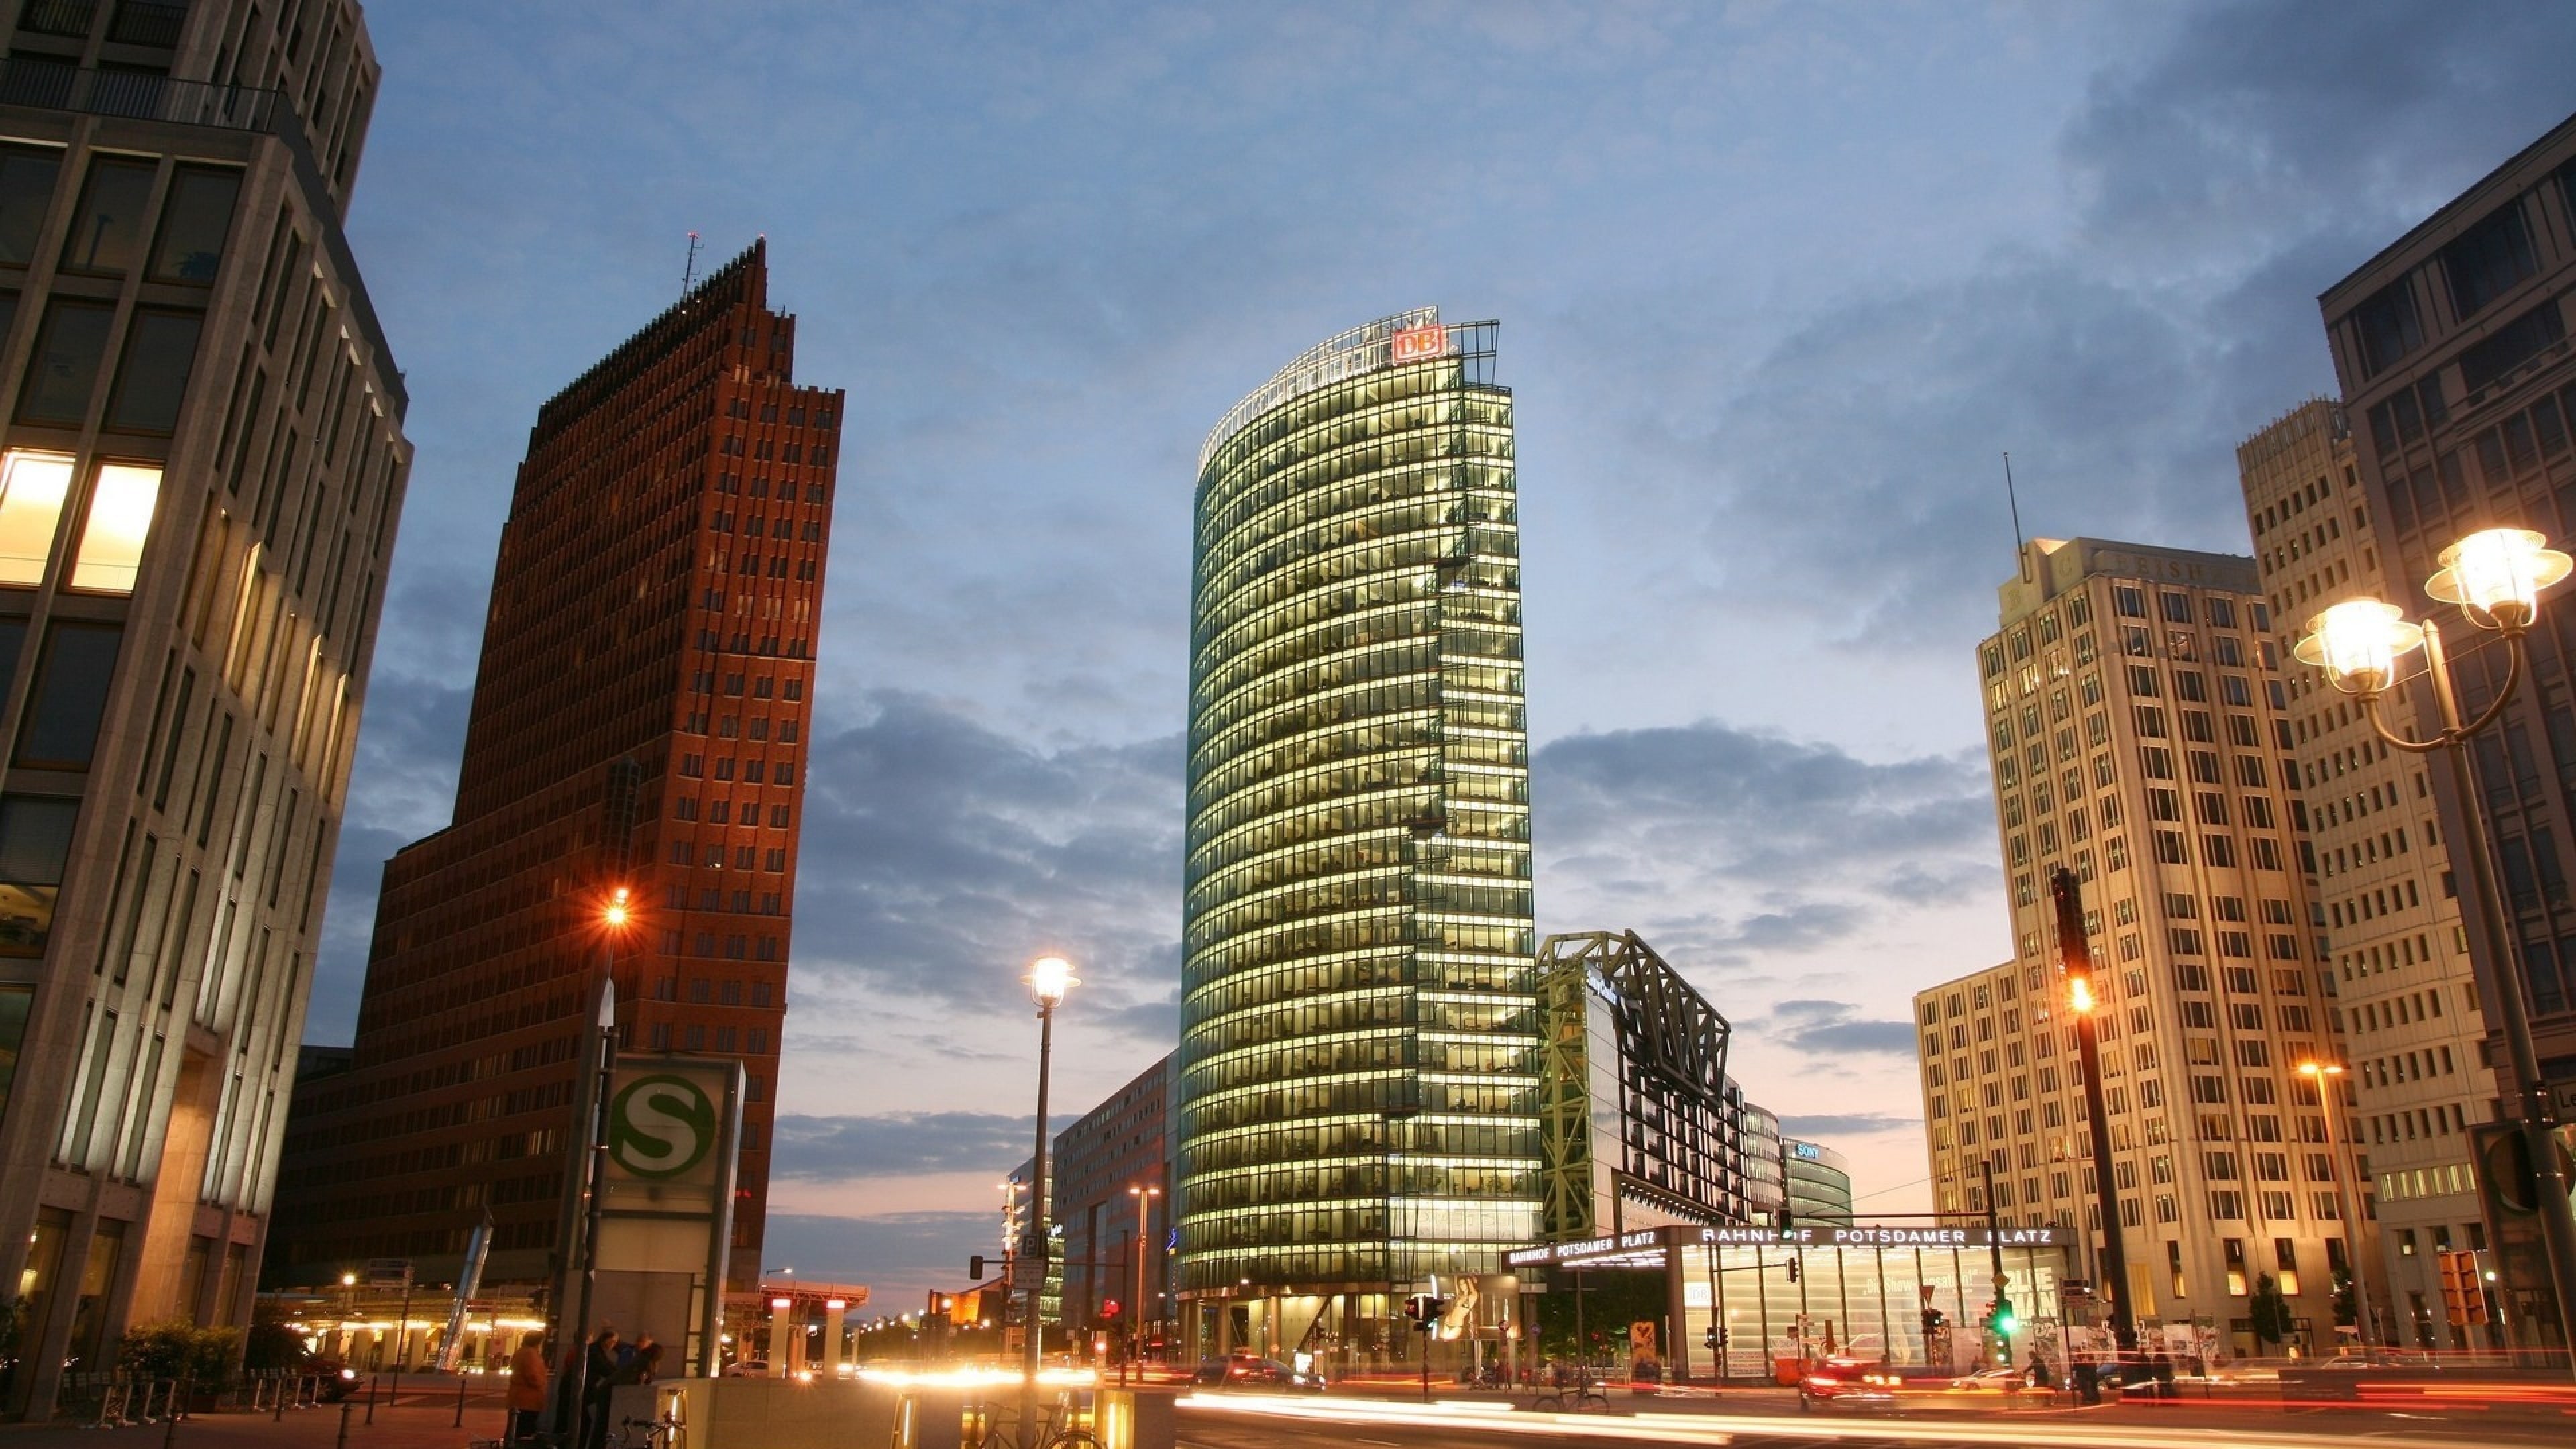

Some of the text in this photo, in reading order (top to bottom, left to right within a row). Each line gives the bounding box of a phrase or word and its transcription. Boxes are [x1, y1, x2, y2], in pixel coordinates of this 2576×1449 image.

[1399, 331, 1436, 356] DB
[621, 1082, 697, 1171] S
[1797, 1143, 1819, 1159] SONY
[1509, 1230, 1656, 1264] BAHNHOF POTSDAMER PLATZ
[1702, 1229, 1812, 1242] BAHNHF
[1835, 1229, 1966, 1242] POTSDAMER
